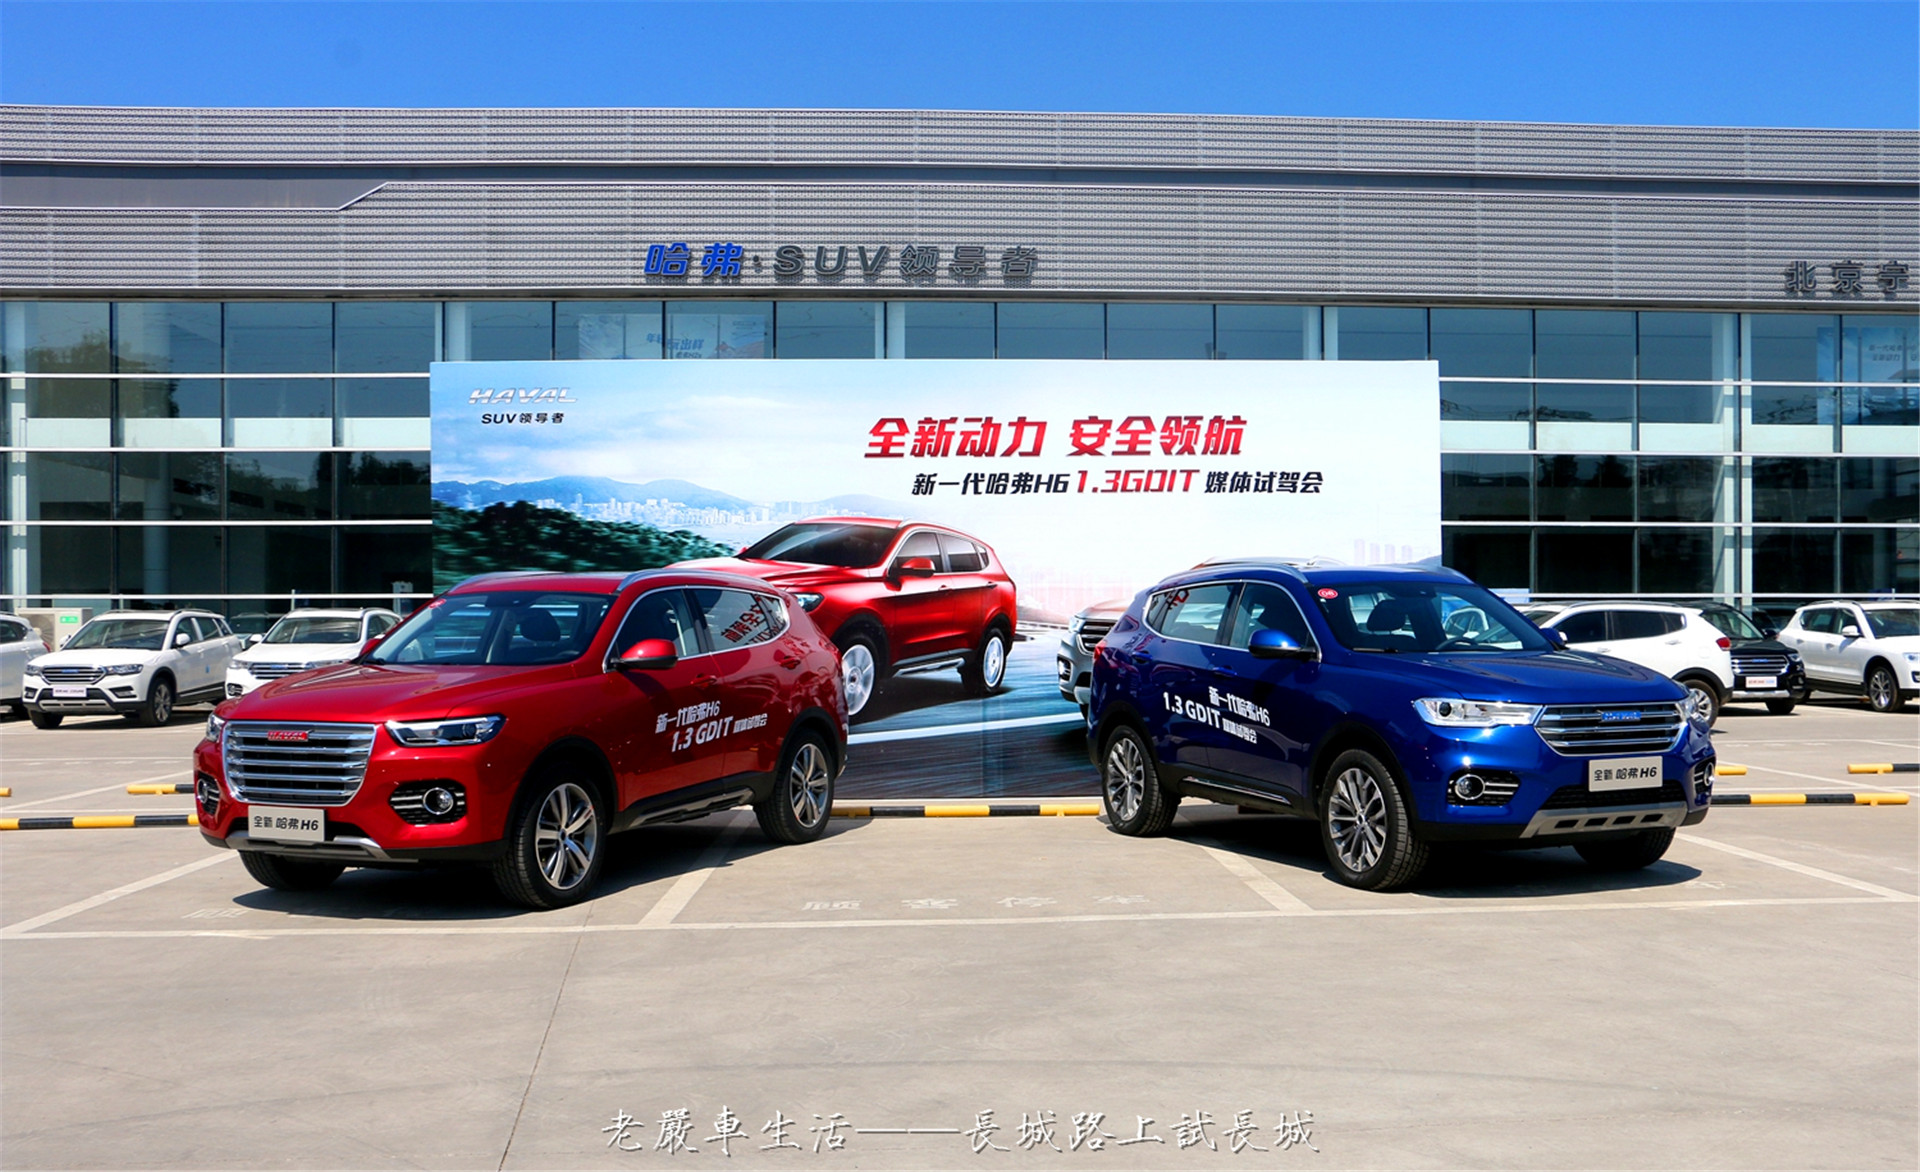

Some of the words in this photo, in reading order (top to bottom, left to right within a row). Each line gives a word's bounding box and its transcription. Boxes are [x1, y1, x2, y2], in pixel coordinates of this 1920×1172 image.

[468, 386, 578, 405] HAVAL
[480, 412, 565, 425] SUV领导者
[865, 415, 1047, 458] 全新动力
[1066, 415, 1248, 457] 安全领航
[912, 472, 1069, 496] 新一代哈弗H6
[1076, 469, 1200, 493] 1.3GDIT
[1204, 471, 1324, 494] 媒体试驾会
[1163, 691, 1184, 715] 1.3
[1185, 700, 1221, 729] GDIT
[671, 727, 694, 752] 1.3
[695, 716, 734, 745] GDIT
[1594, 769, 1613, 781] 全新
[1615, 766, 1658, 780] 哈弗H6
[254, 815, 272, 828] 全新
[275, 816, 319, 831] 哈弗H6
